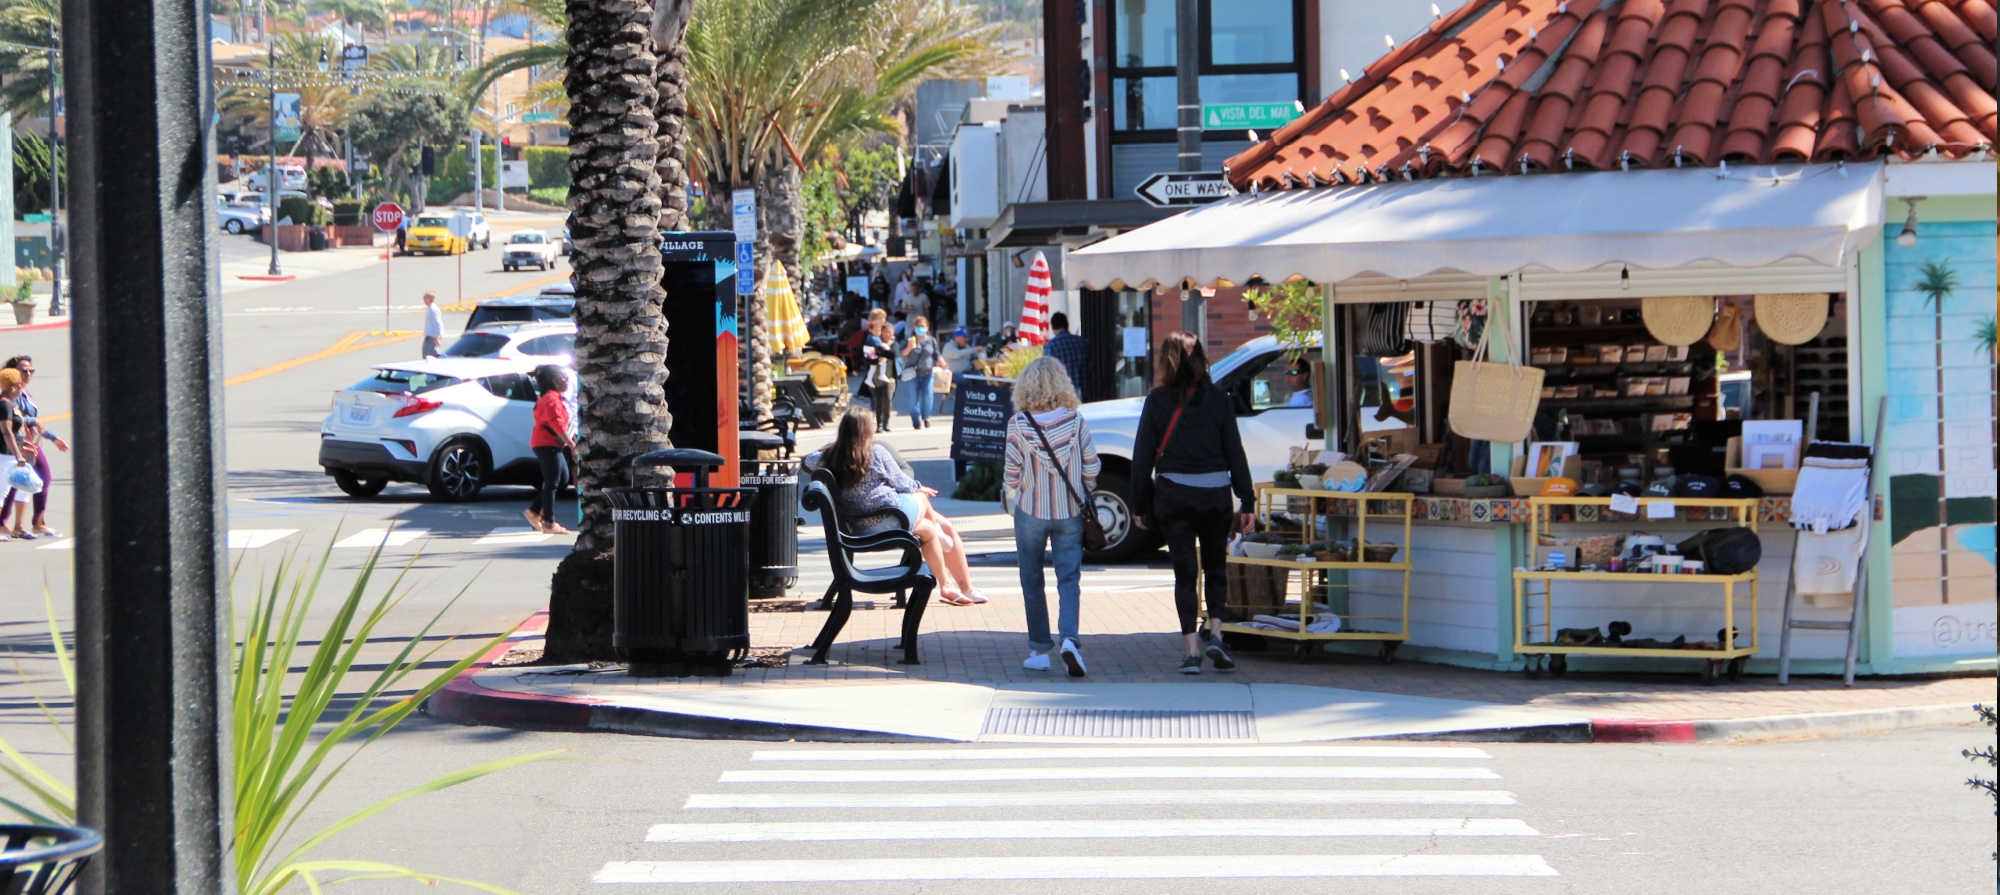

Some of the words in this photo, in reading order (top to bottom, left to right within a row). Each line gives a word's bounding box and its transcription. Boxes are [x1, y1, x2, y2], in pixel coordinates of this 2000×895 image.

[1221, 106, 1246, 120] VISTA
[1249, 106, 1267, 120] DEL
[1270, 105, 1290, 119] MAR
[1165, 183, 1191, 196] ONE
[1196, 182, 1223, 194] WAY
[376, 211, 401, 222] STOP
[965, 390, 986, 401] Vista
[963, 406, 1004, 420] Sotheby's
[961, 426, 1006, 438] 310.541.8271
[762, 476, 774, 485] FOR
[623, 509, 660, 521] RECYCLING
[694, 512, 733, 524] CONTENTS
[733, 511, 744, 523] WILL
